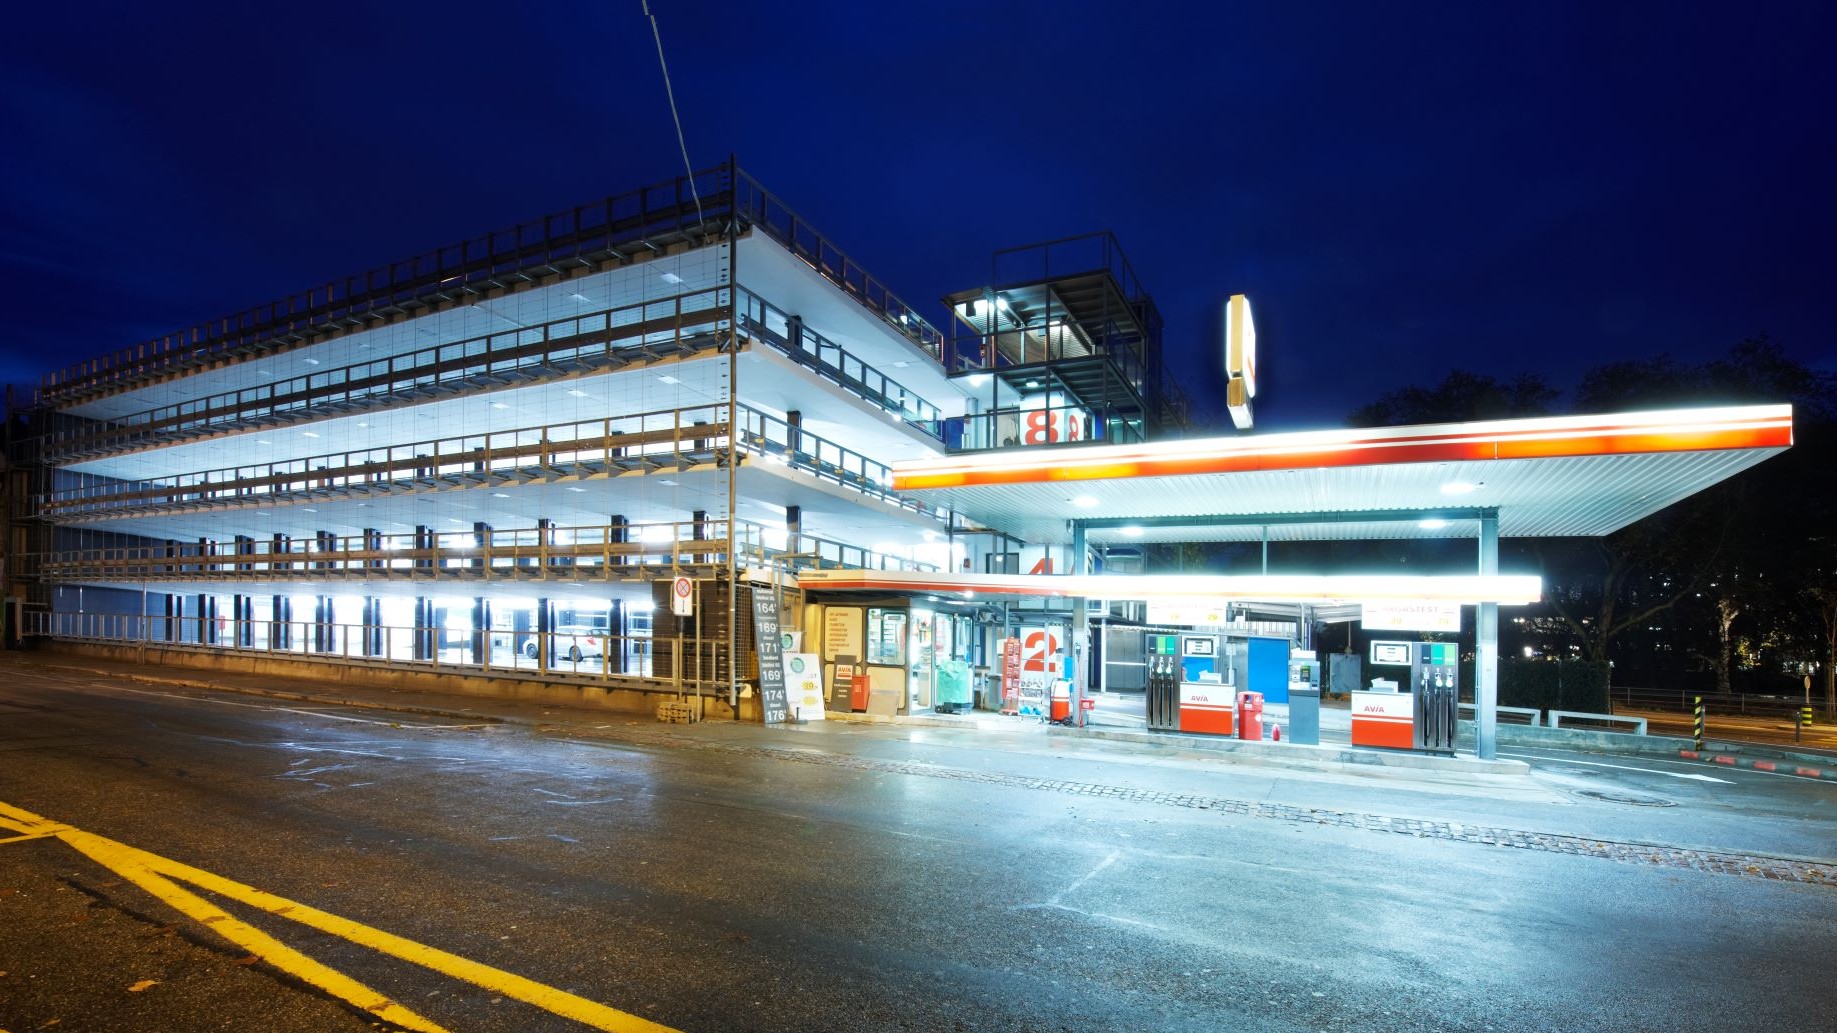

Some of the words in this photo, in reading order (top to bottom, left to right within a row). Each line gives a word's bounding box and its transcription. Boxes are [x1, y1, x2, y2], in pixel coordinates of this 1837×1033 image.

[1025, 410, 1059, 445] 8
[1024, 632, 1057, 672] 2
[1364, 705, 1385, 713] AVIA
